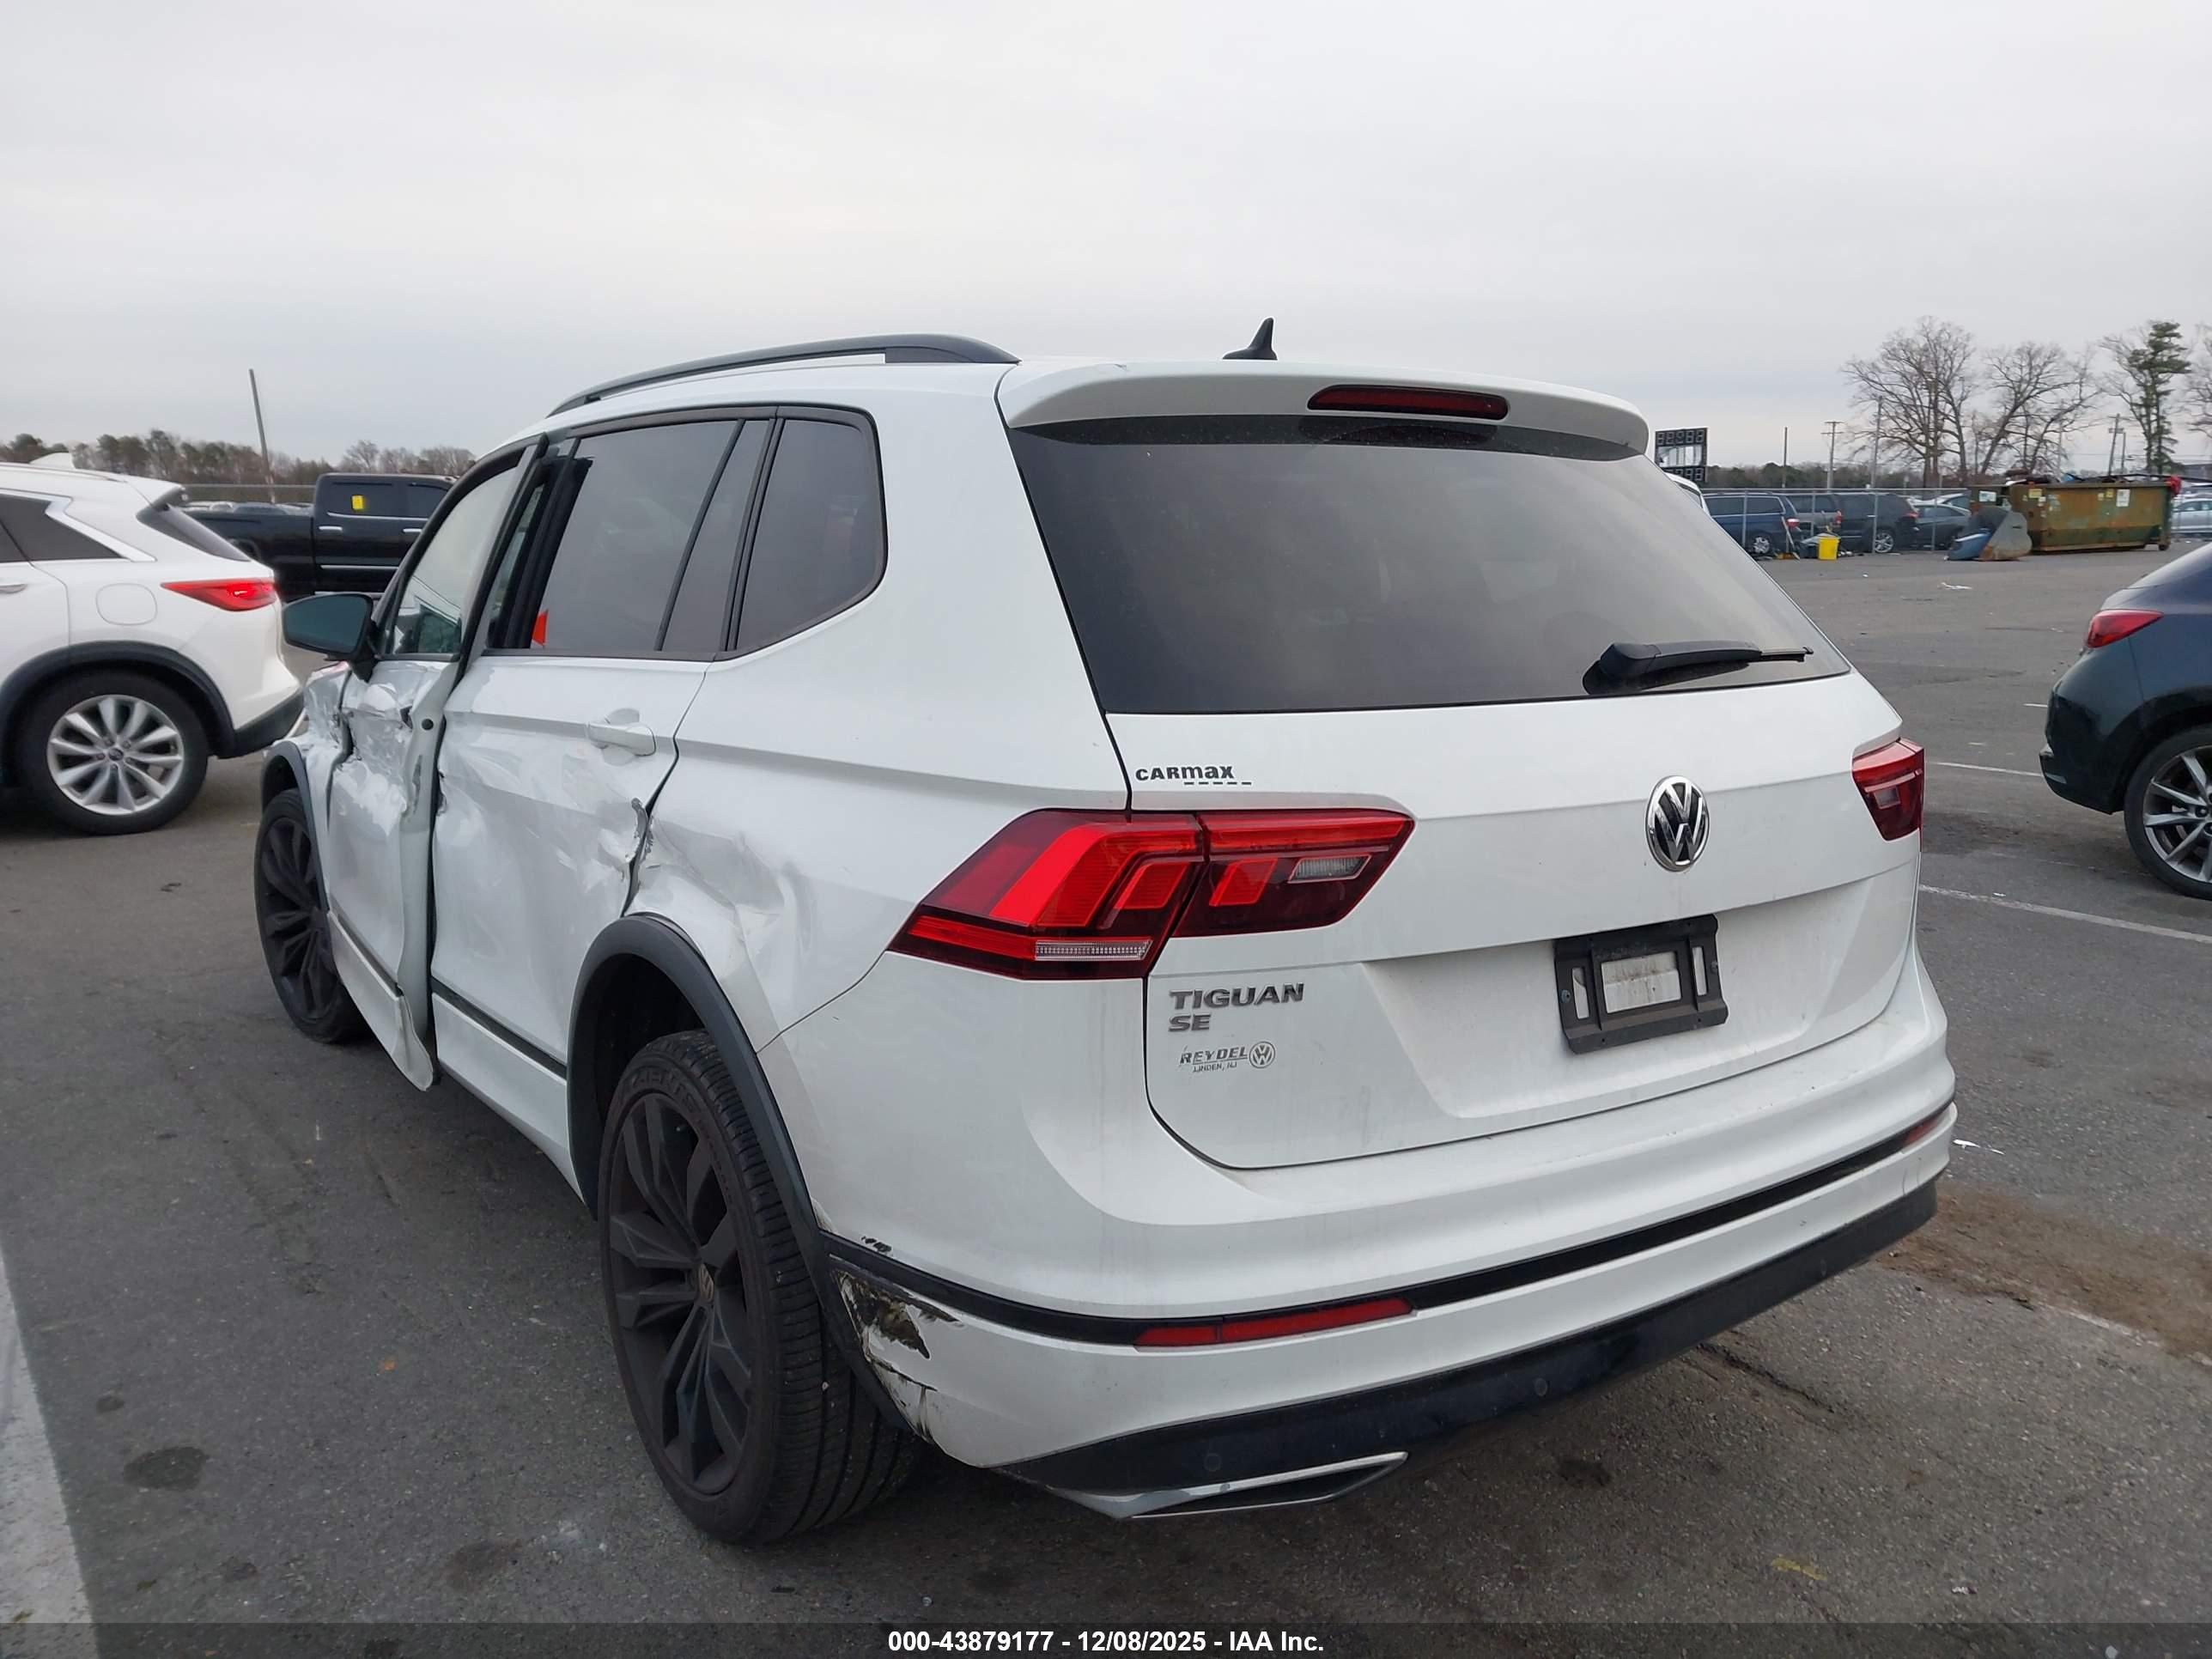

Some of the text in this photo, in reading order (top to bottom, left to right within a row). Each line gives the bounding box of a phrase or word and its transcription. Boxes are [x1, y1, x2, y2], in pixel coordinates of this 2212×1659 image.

[1169, 983, 1304, 1011] TIGUAN
[1168, 1013, 1212, 1033] SE
[1179, 1045, 1249, 1066] REYDEL
